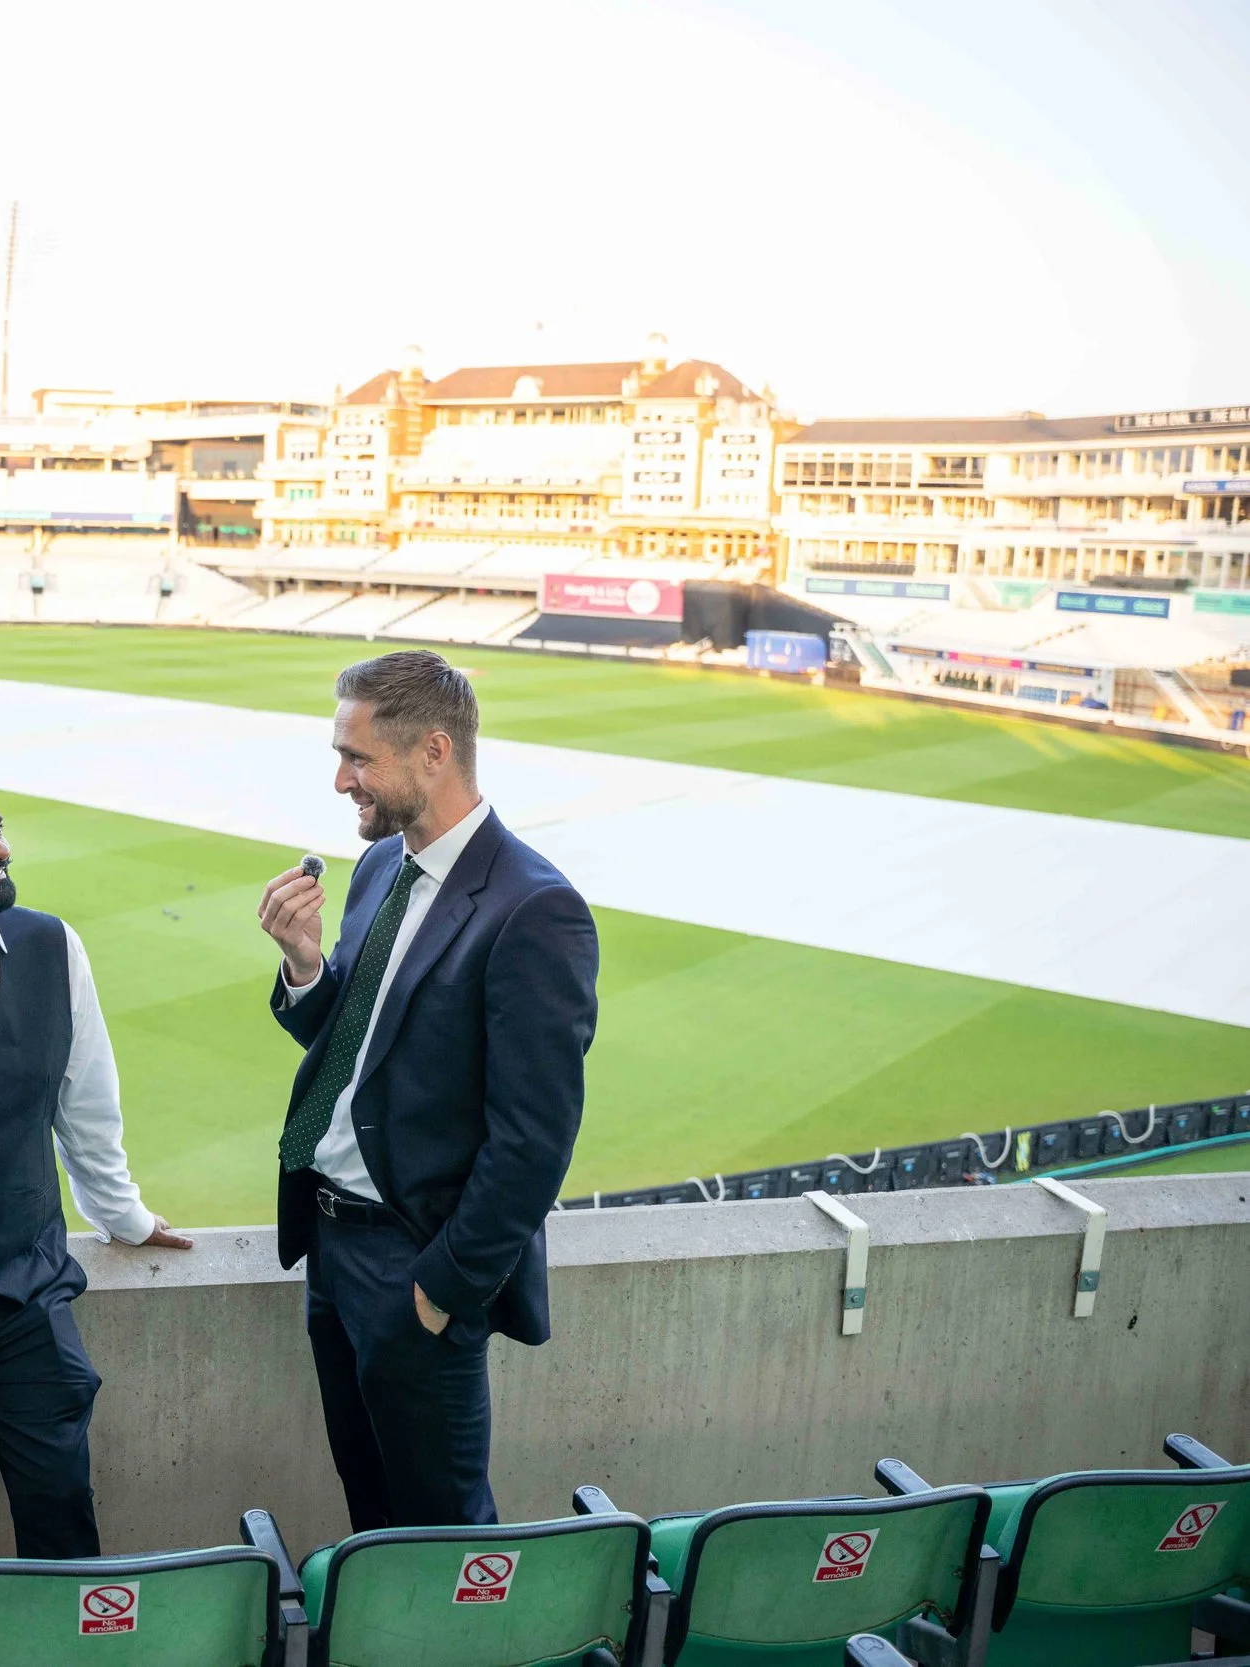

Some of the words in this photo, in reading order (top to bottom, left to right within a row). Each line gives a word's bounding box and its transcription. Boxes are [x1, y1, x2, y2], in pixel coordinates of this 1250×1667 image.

[823, 1570, 857, 1579] smoking
[476, 1588, 490, 1596] No
[462, 1593, 500, 1601] smoking
[88, 1623, 129, 1632] smoking
